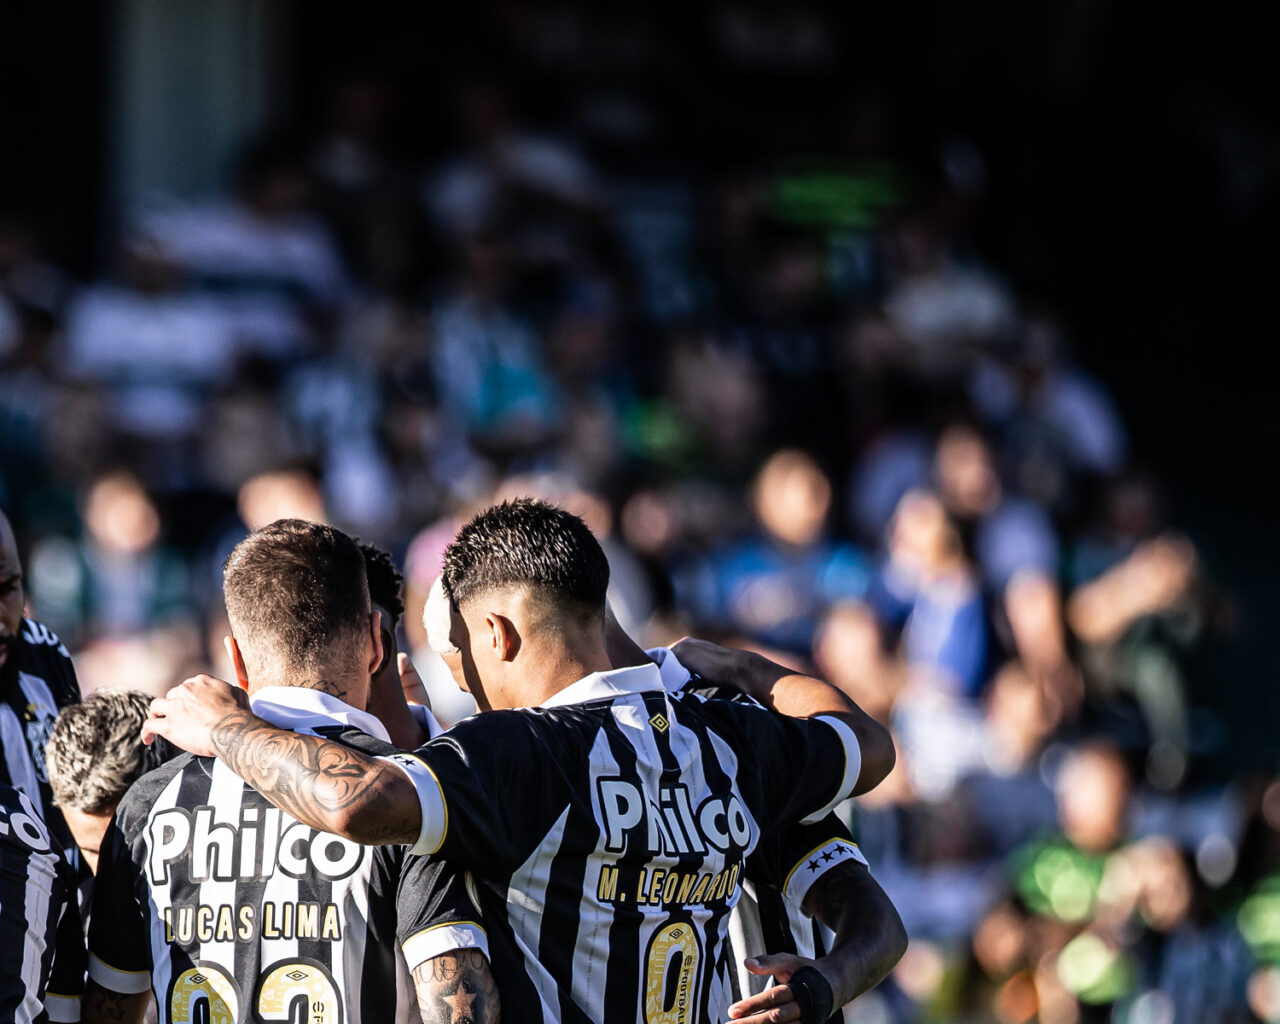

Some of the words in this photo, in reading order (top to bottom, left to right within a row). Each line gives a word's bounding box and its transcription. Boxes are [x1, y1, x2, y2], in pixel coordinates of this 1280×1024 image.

[600, 780, 750, 853] Philco
[150, 806, 363, 885] Philco
[599, 866, 626, 902] M.
[636, 864, 739, 904] LEONARDO
[165, 902, 256, 943] LUCAS
[263, 901, 341, 940] LIMA
